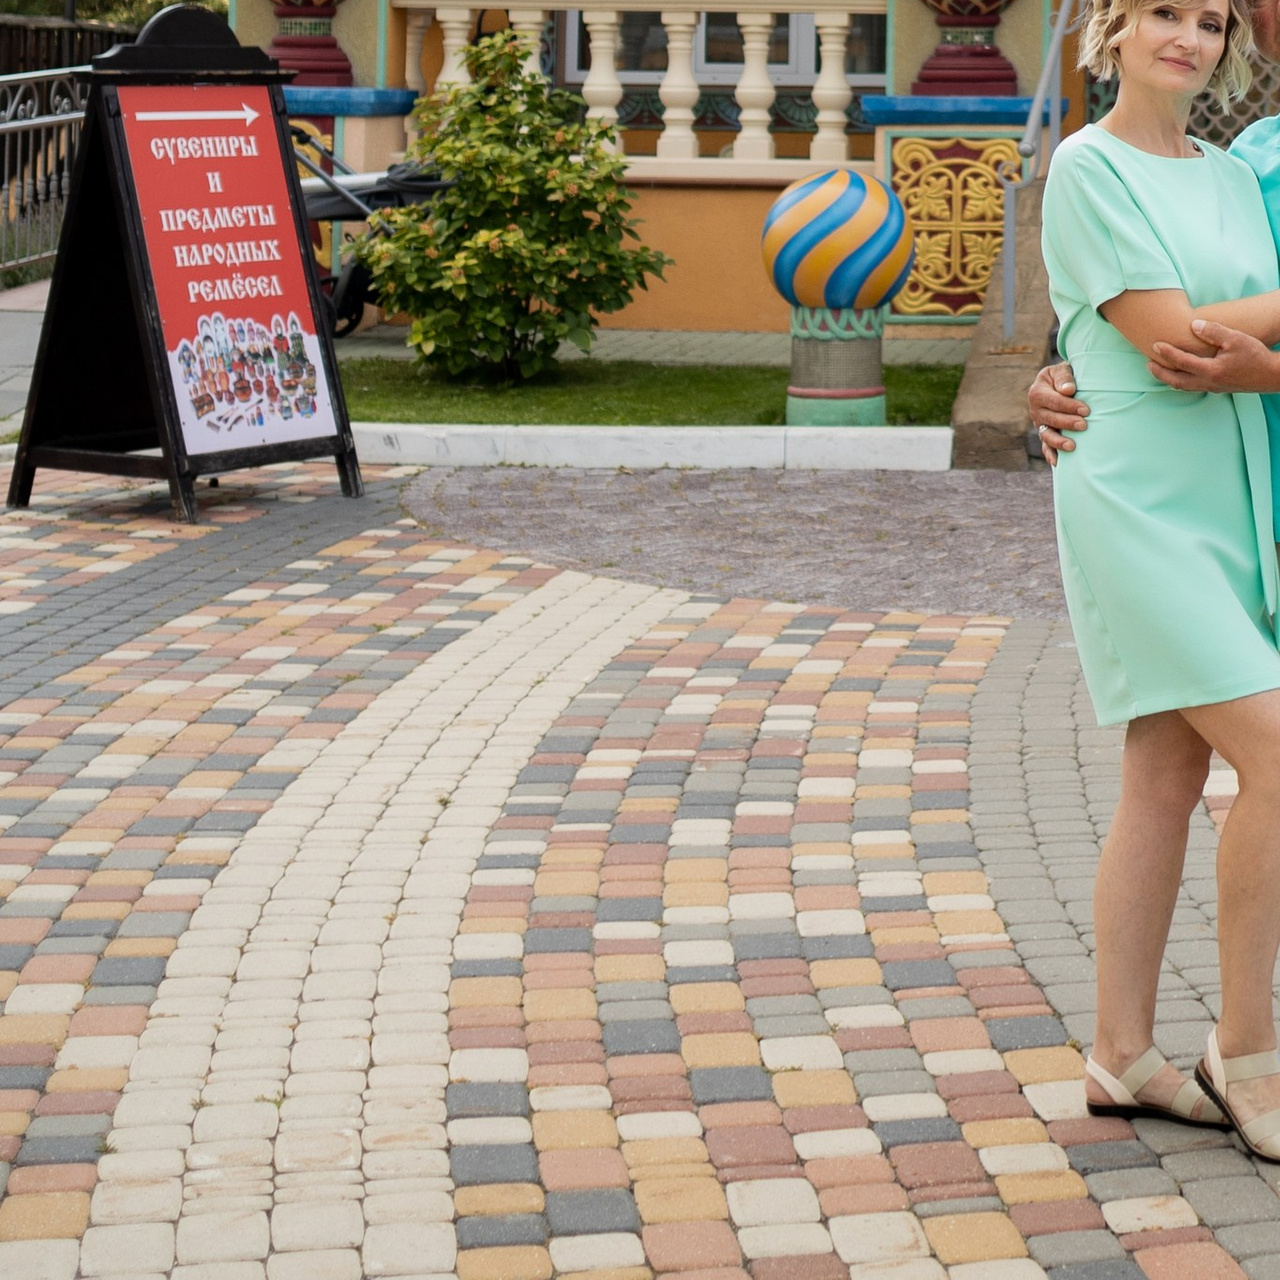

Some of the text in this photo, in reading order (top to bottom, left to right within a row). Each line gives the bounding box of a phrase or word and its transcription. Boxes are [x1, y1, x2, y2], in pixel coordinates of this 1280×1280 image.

[150, 135, 259, 165] СУВЕНИРЫ
[206, 171, 224, 193] И
[159, 204, 277, 233] ПРЕДМЕТЫ
[172, 239, 282, 268] НАРОДНЫХ
[187, 272, 283, 303] РЕМЁСЕЛ
